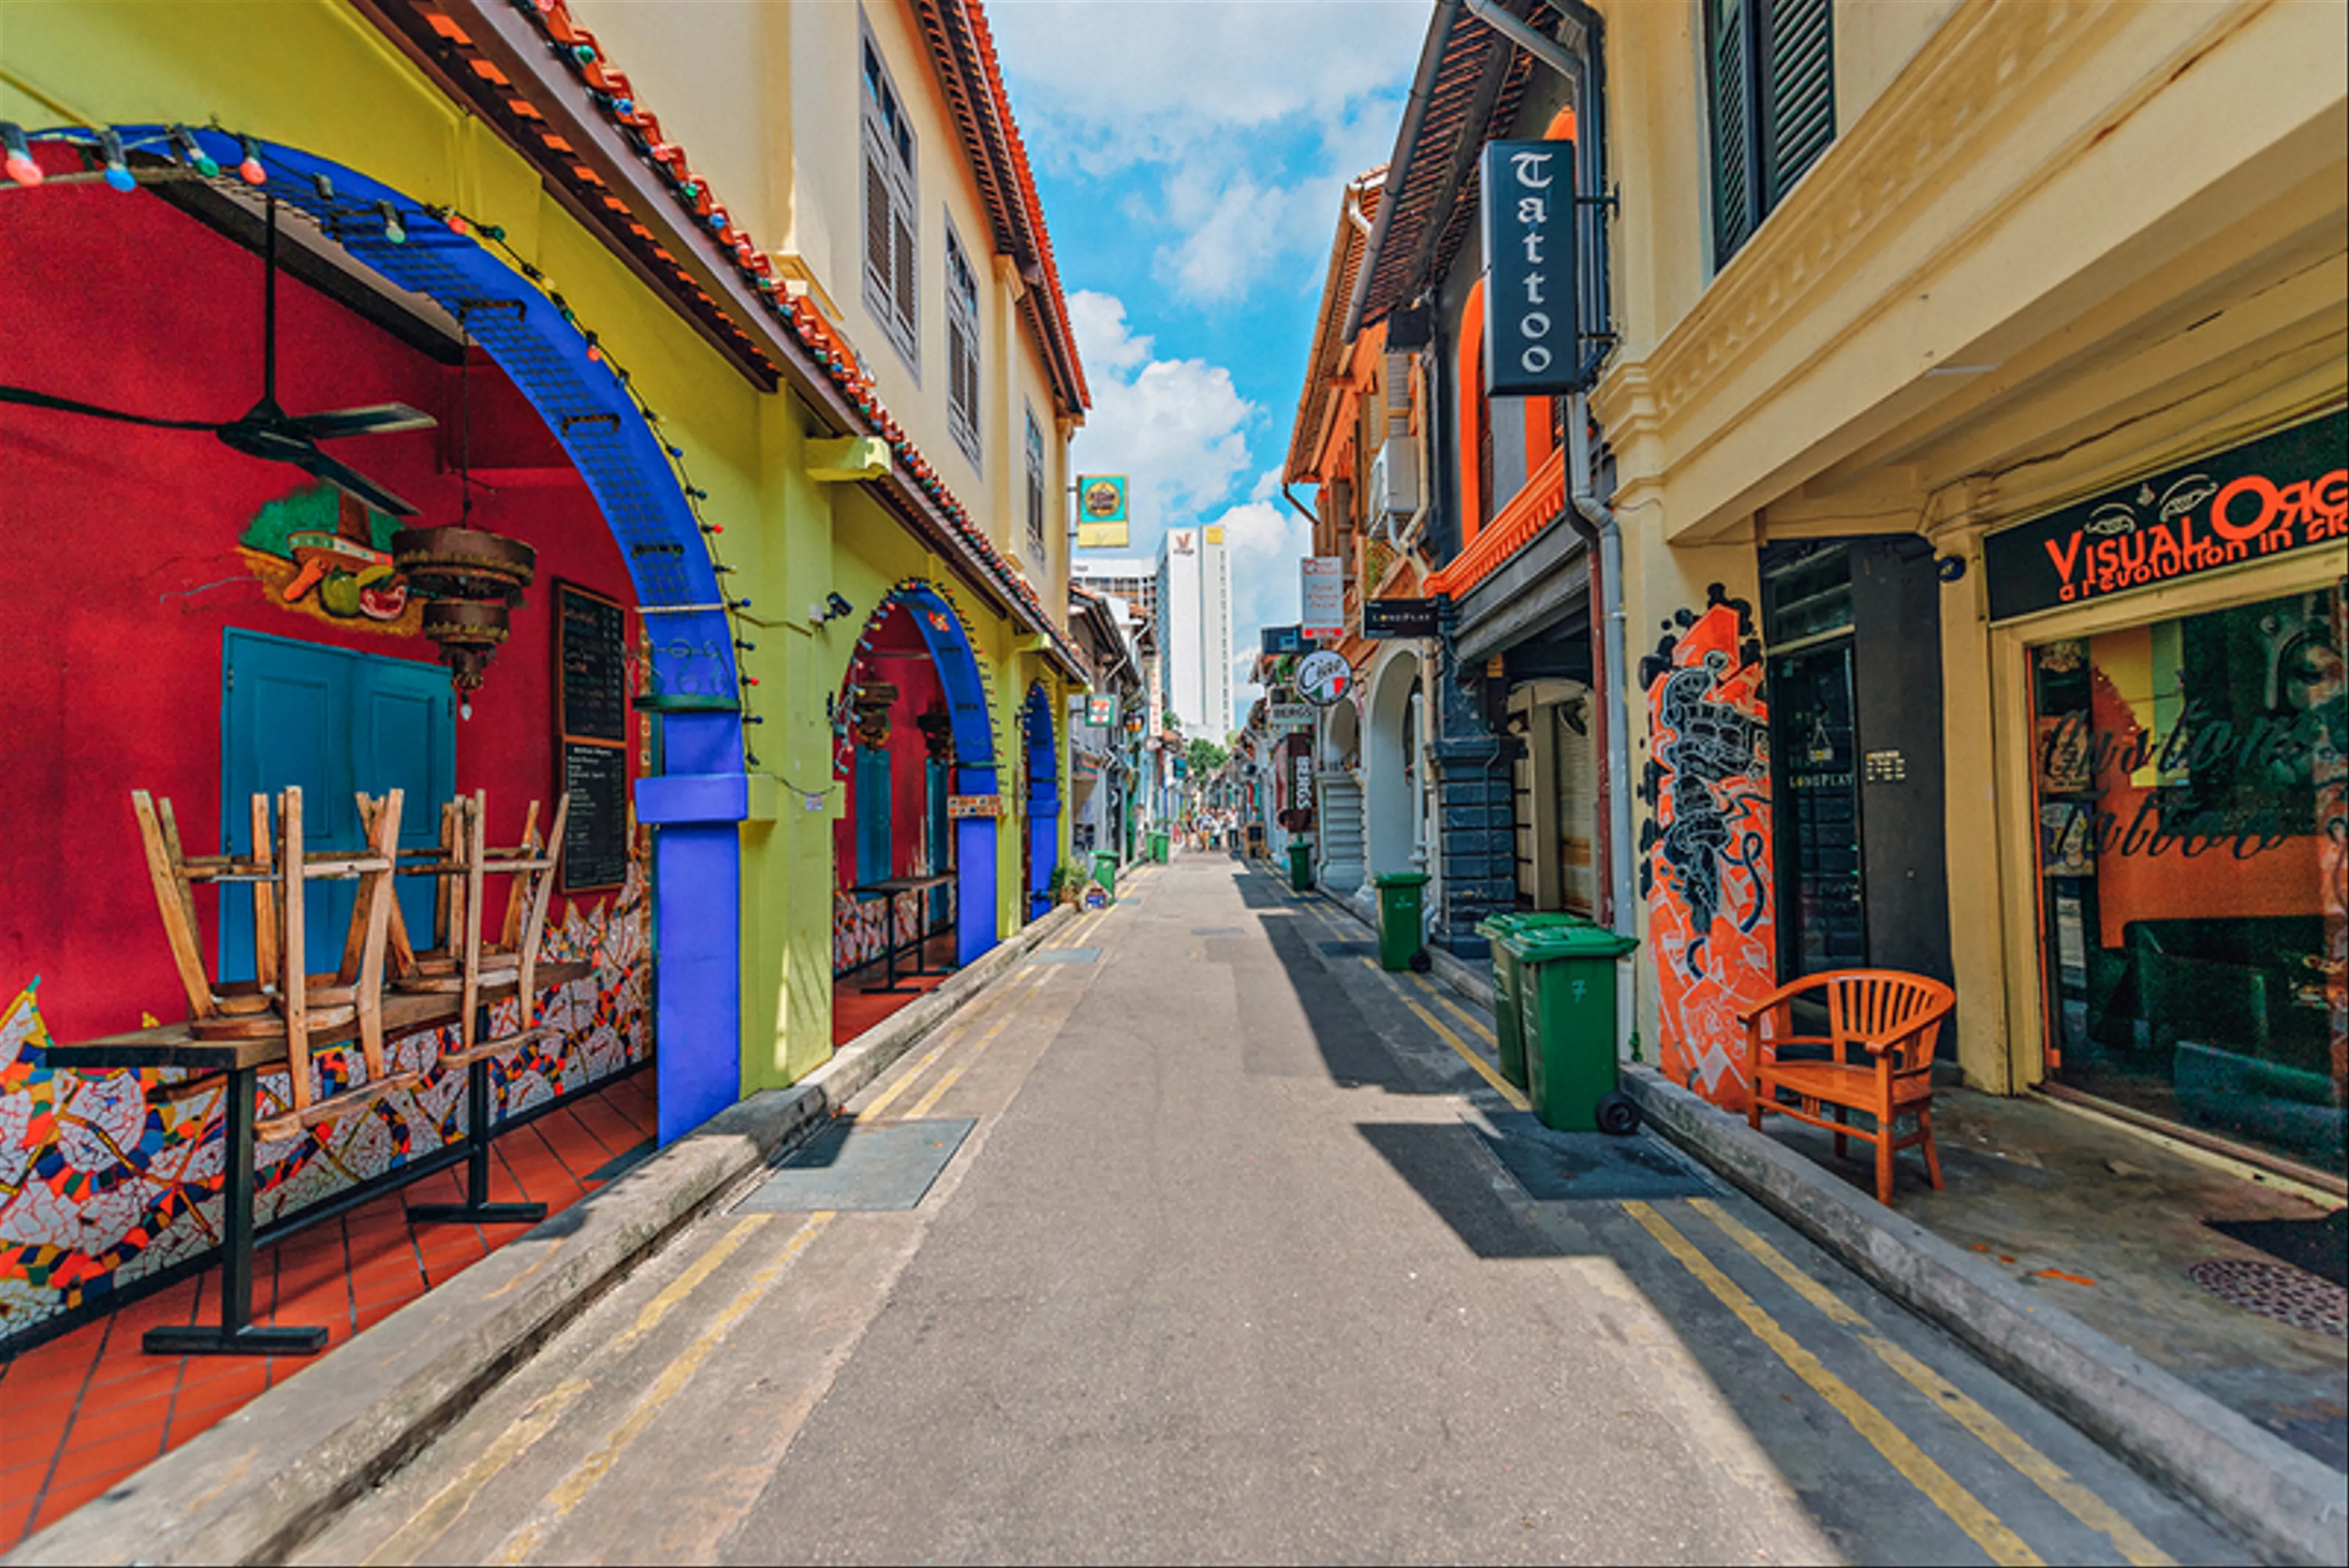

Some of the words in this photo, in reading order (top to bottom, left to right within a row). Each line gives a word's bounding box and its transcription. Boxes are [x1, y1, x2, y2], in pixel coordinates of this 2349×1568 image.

[1510, 152, 1554, 374] Tattoo
[2059, 582, 2076, 602] a
[2260, 529, 2293, 554] in
